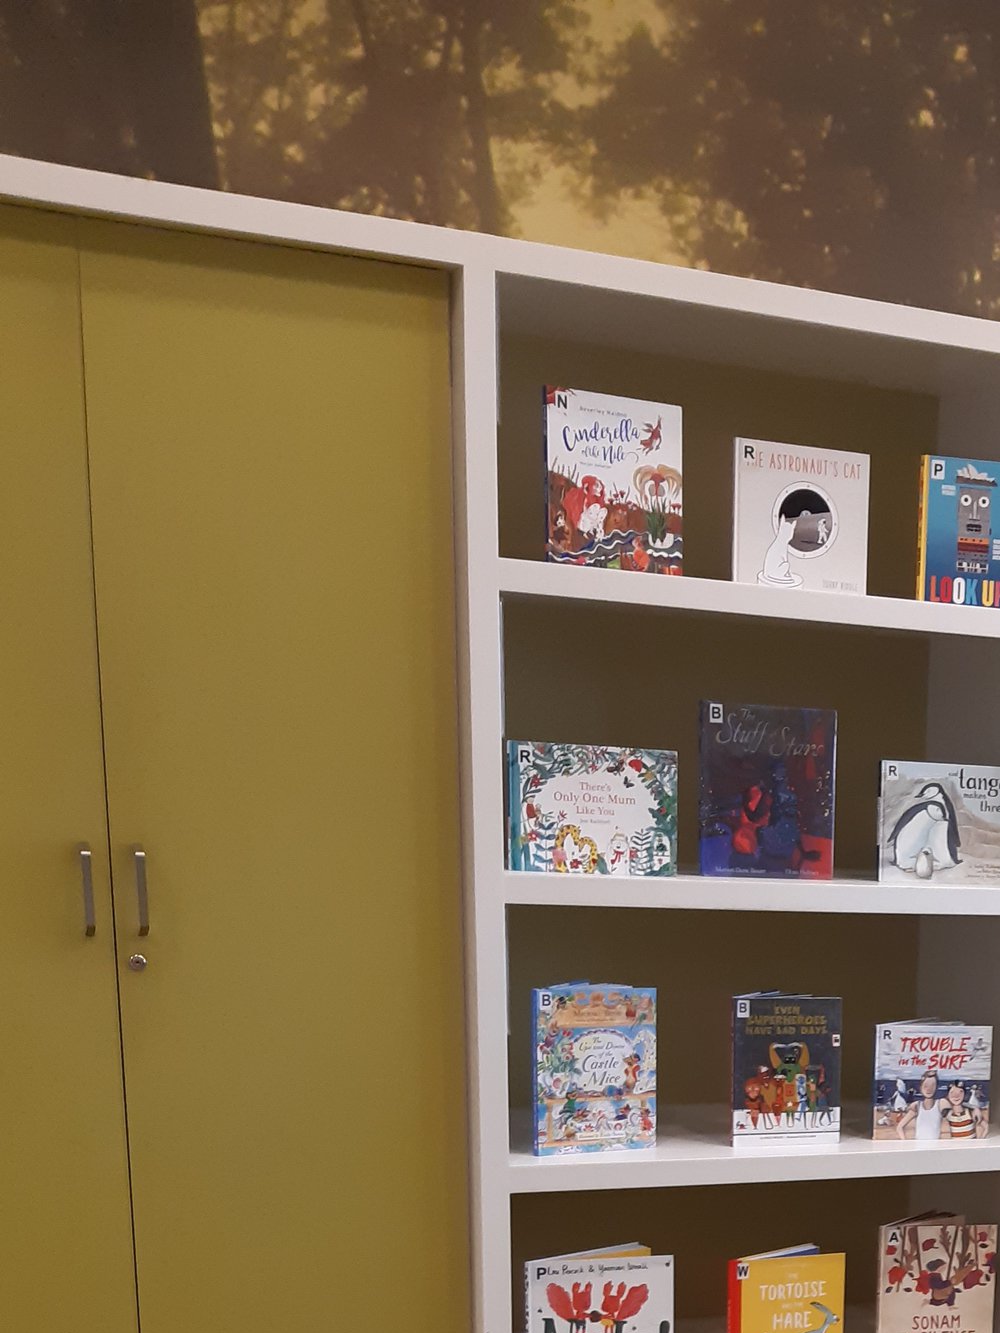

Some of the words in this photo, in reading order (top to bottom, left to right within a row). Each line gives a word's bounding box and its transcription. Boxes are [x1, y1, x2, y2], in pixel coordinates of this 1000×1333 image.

[557, 394, 568, 410] N
[562, 418, 640, 452] Cinderella
[602, 444, 625, 464] Nile
[743, 445, 755, 460] R
[769, 453, 839, 478] ASTRONAUT'S
[843, 462, 862, 480] CAT
[933, 463, 944, 477] P
[929, 574, 979, 606] LOOK
[711, 706, 721, 720] B
[716, 712, 769, 753] Stuff
[769, 726, 825, 757] Stars
[519, 750, 531, 764] R
[888, 765, 898, 777] R
[579, 781, 612, 793] There's
[553, 791, 579, 806] Only
[582, 792, 604, 804] One
[607, 794, 637, 806] Mum
[575, 805, 595, 816] Like
[598, 805, 615, 816] You
[541, 994, 551, 1007] B
[738, 1002, 748, 1014] B
[883, 1029, 892, 1040] R
[900, 1036, 972, 1053] TROUBLE
[582, 1054, 620, 1073] Castle
[898, 1058, 909, 1066] in
[927, 1054, 973, 1071] SURF
[588, 1072, 621, 1087] Mice
[889, 1232, 899, 1243] A
[536, 1267, 547, 1280] P
[738, 1265, 749, 1277] W
[759, 1280, 827, 1301] TORTOISE
[772, 1311, 813, 1330] HARE
[911, 1314, 961, 1331] SONAM
